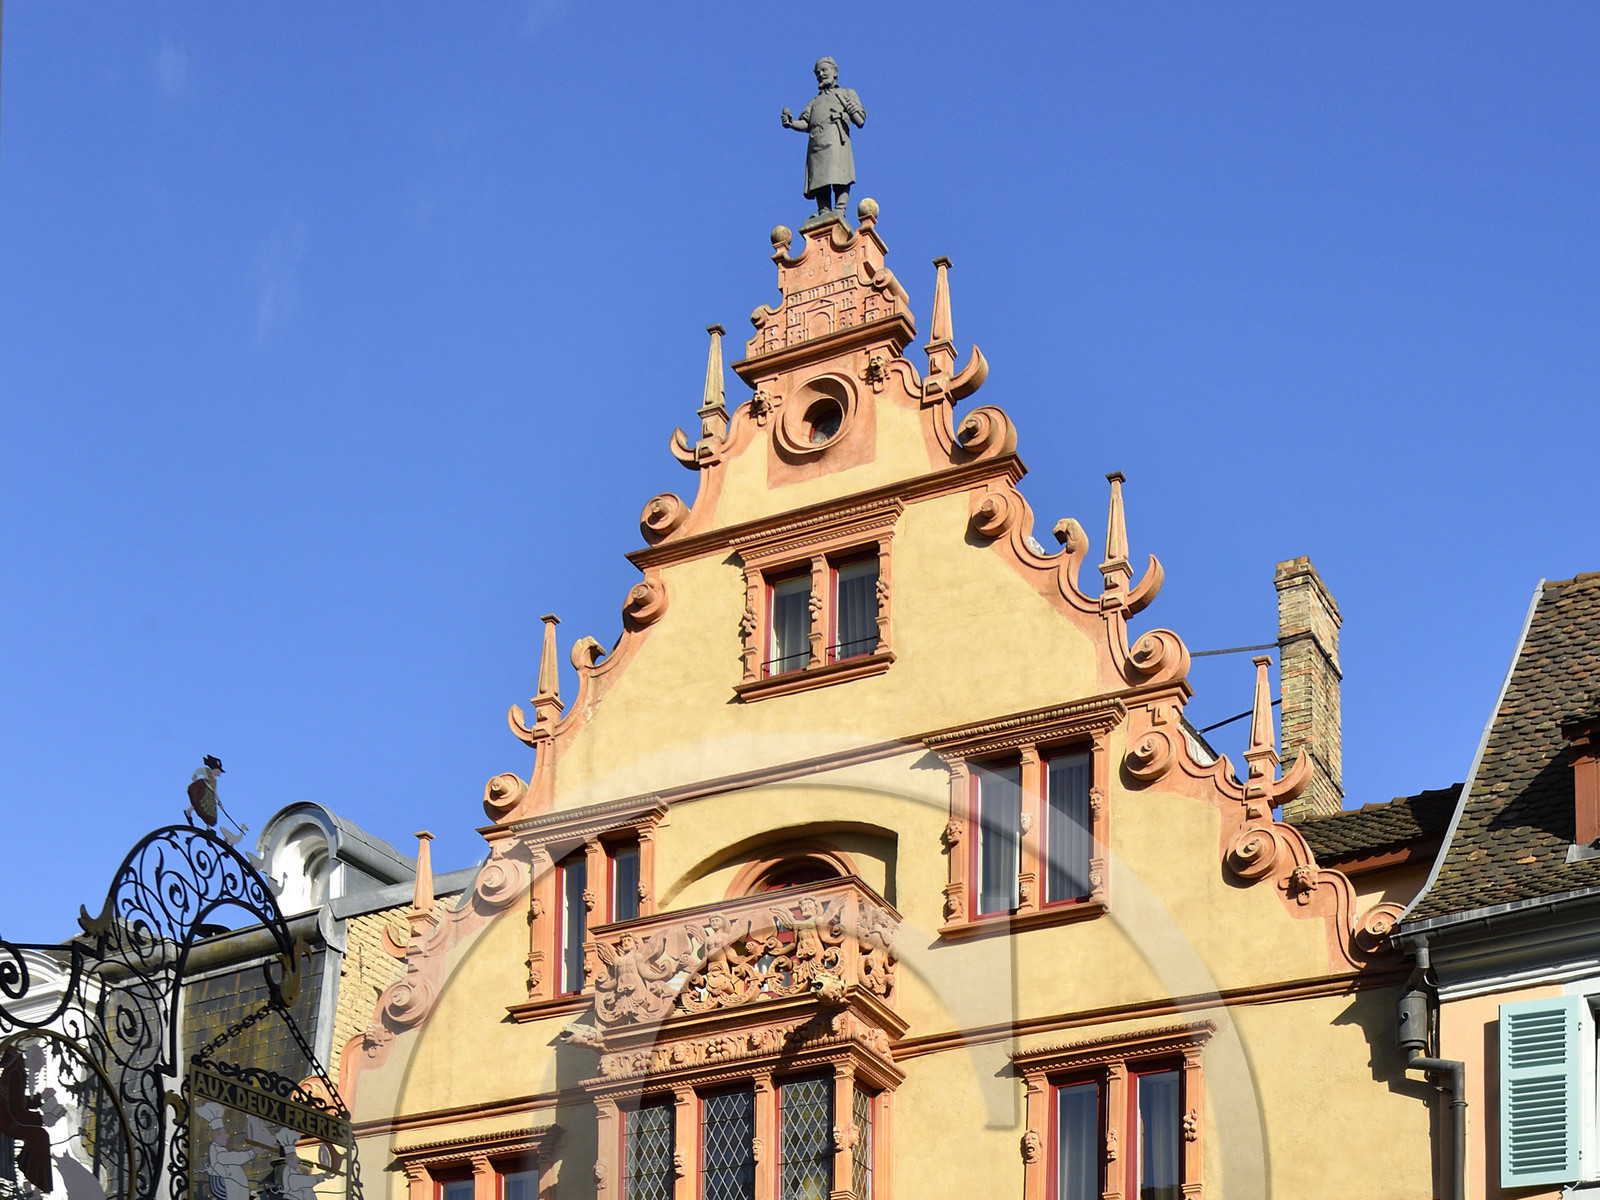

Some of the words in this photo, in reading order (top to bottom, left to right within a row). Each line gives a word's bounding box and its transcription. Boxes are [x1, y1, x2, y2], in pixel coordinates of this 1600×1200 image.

[195, 1074, 231, 1104] AUX
[236, 1087, 281, 1122] DEUX
[284, 1106, 349, 1142] FRERES
